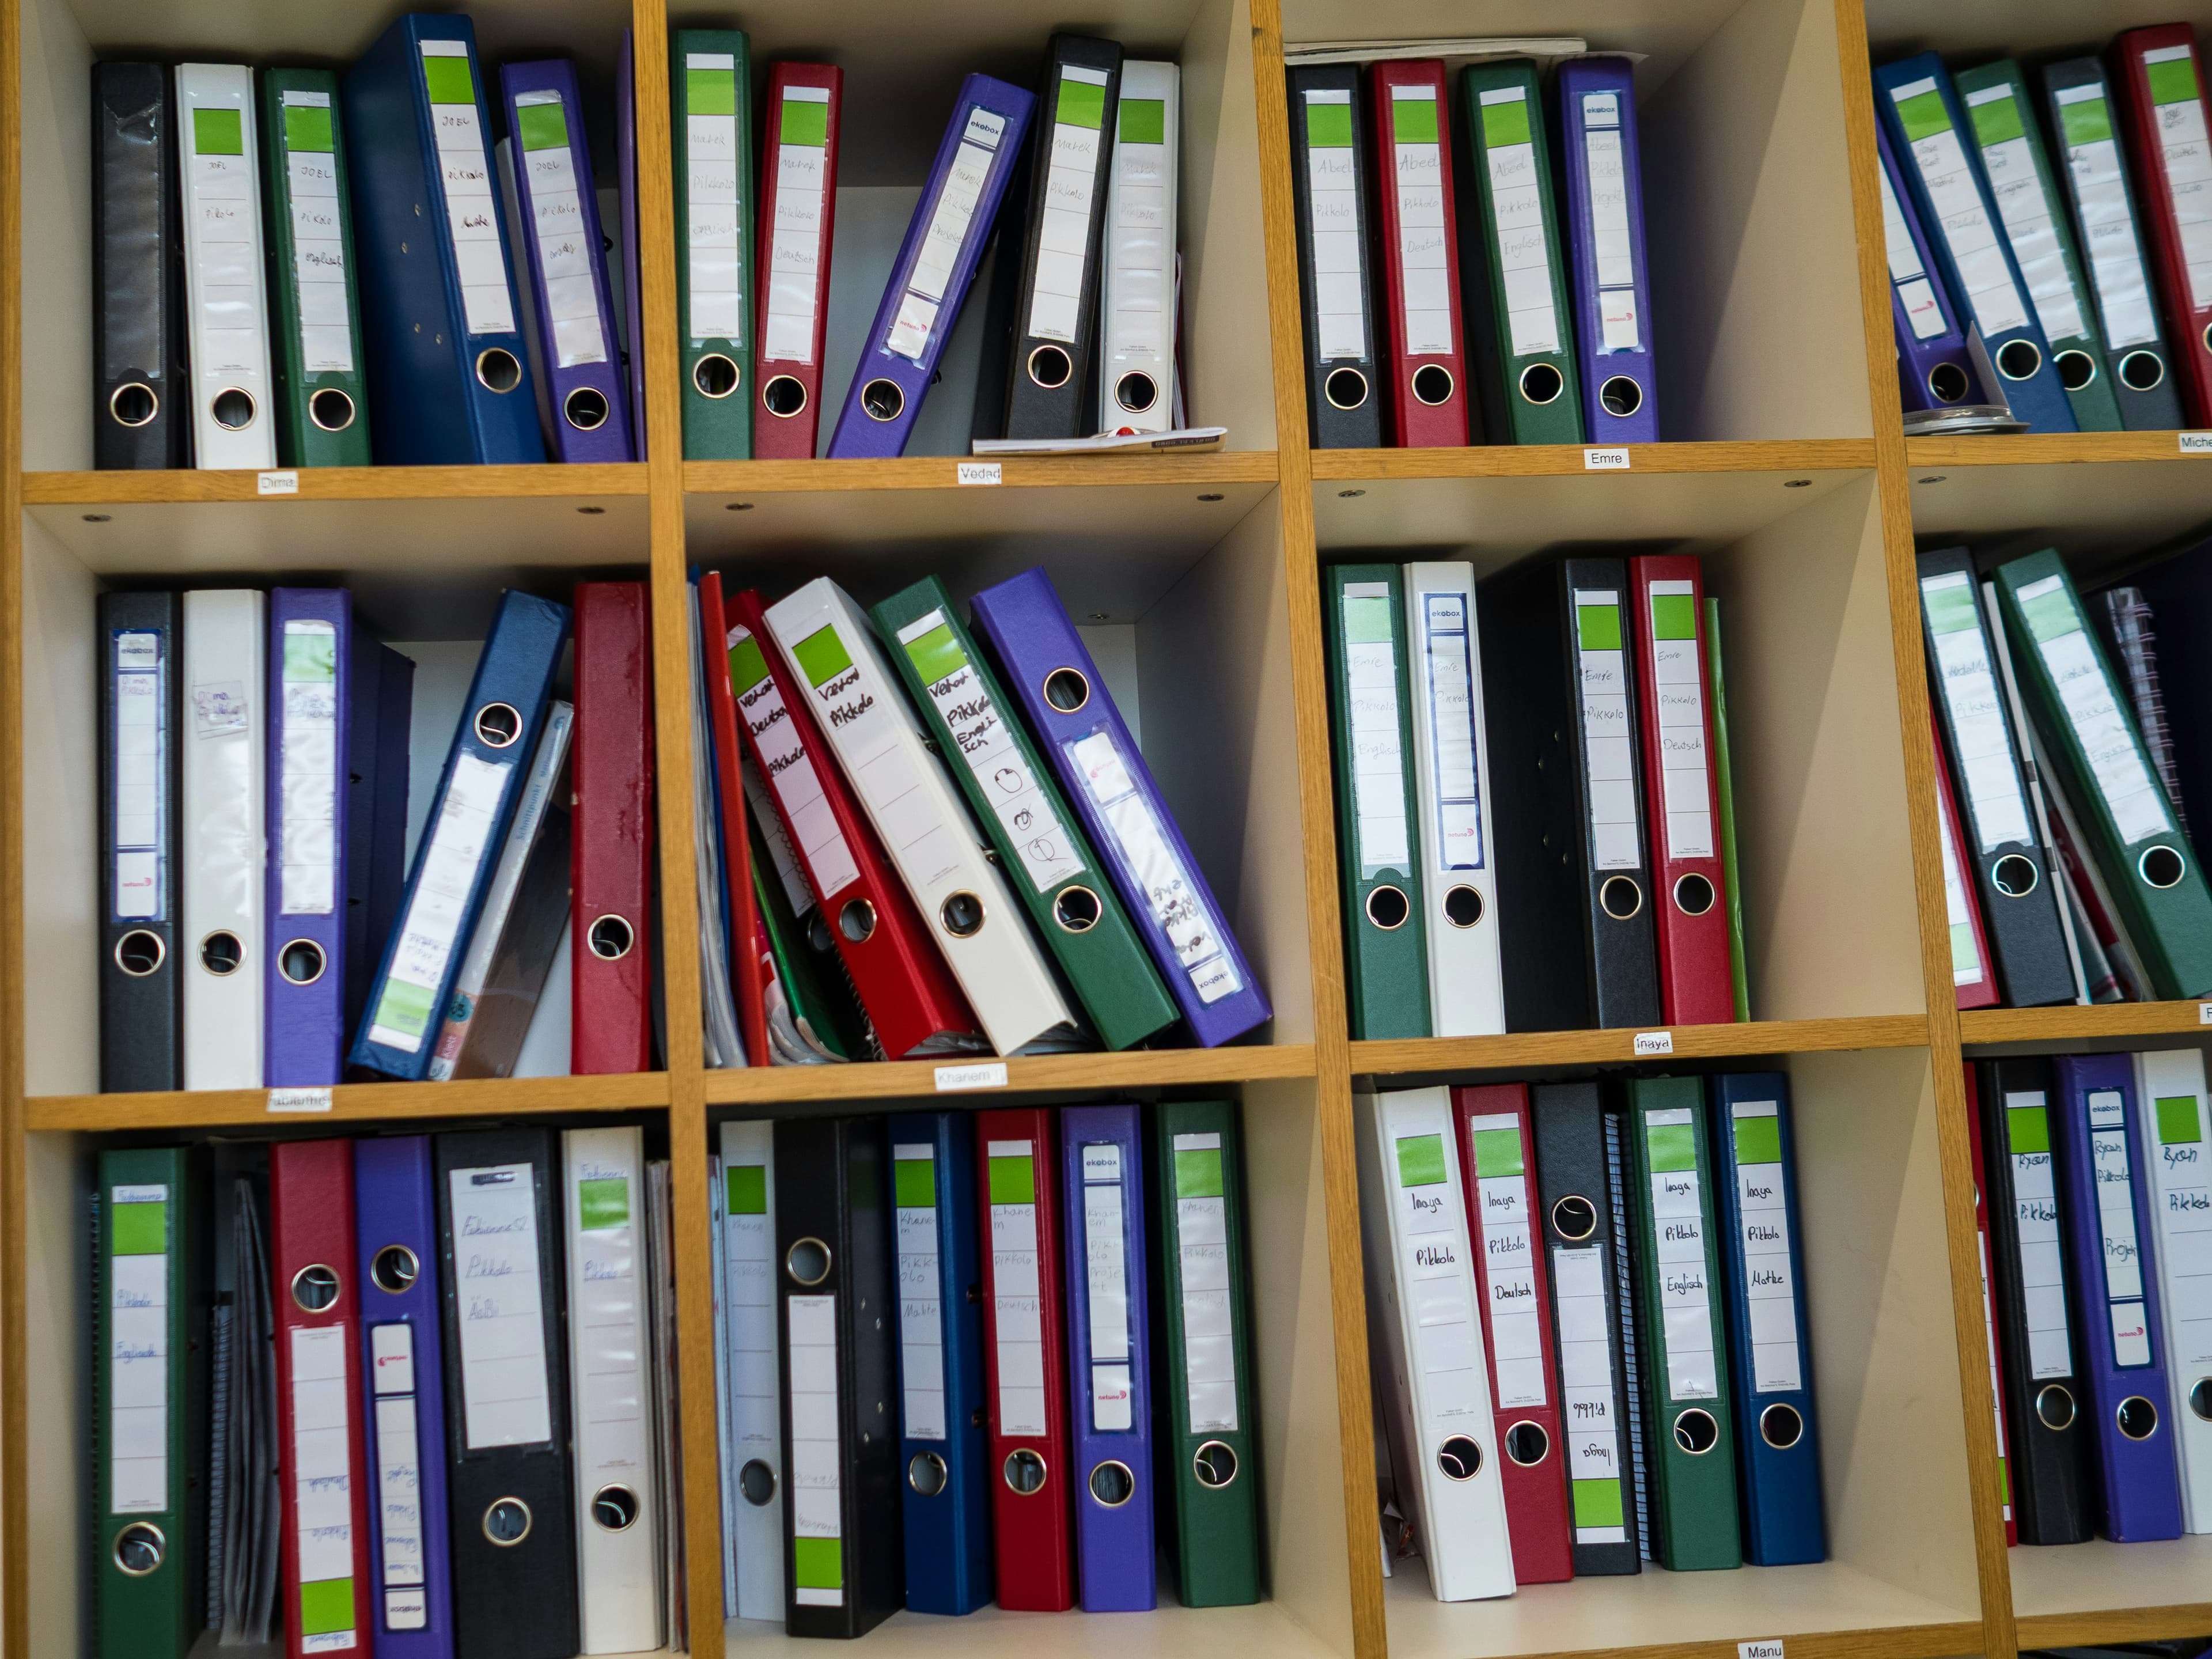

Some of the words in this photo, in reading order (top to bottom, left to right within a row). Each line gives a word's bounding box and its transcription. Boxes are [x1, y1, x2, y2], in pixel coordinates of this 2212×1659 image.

[442, 116, 470, 126] JOEL
[970, 120, 1000, 136] ekobox
[691, 134, 725, 146] Marek
[1058, 138, 1091, 154] Marek
[208, 161, 226, 170] JOEL
[536, 161, 560, 171] JOEL
[781, 158, 816, 171] Marek
[301, 166, 332, 178] JOEL
[1406, 238, 1443, 253] Deutsch
[775, 250, 815, 264] Deutsch
[900, 320, 921, 332] netuno
[2182, 437, 2212, 447] Miche
[1591, 453, 1622, 464] Emre
[962, 467, 1000, 479] Vedad
[1353, 656, 1385, 669] Emre
[1657, 651, 1683, 662] Emre
[1434, 661, 1460, 673] Emre
[1584, 669, 1613, 681] Emre
[1660, 695, 1698, 706] Pikkolo
[830, 694, 874, 728] Pikkolo
[1587, 706, 1624, 720] Pikkolo
[1663, 738, 1702, 750] Deutsch
[1198, 970, 1228, 990] ekobox
[1637, 1039, 1669, 1050] Inaya
[2092, 1105, 2120, 1113] ekobox
[2094, 1140, 2122, 1161] Ryan
[1086, 1158, 1118, 1166] ekobox
[2018, 1153, 2050, 1166] Ryan
[2164, 1146, 2198, 1170] Ryan
[1665, 1177, 1691, 1195] Inaya
[1746, 1179, 1772, 1199] Inaya
[1412, 1193, 1443, 1213] Inaya
[1488, 1191, 1516, 1210] Inaya
[2169, 1193, 2210, 1211] Pikkolo
[994, 1221, 1004, 1230] m
[1665, 1224, 1699, 1241] Pikkolo
[1748, 1226, 1780, 1240] Pikkolo
[1489, 1236, 1526, 1254] Pikkolo
[1416, 1247, 1455, 1266] Pikkolo
[1667, 1273, 1703, 1295] Englisch
[1751, 1270, 1785, 1287] Mathe
[1494, 1282, 1531, 1300] Deutsch
[1573, 1402, 1605, 1419] Pikkolo
[1582, 1443, 1611, 1467] Inaya
[1748, 1646, 1782, 1658] Manu
